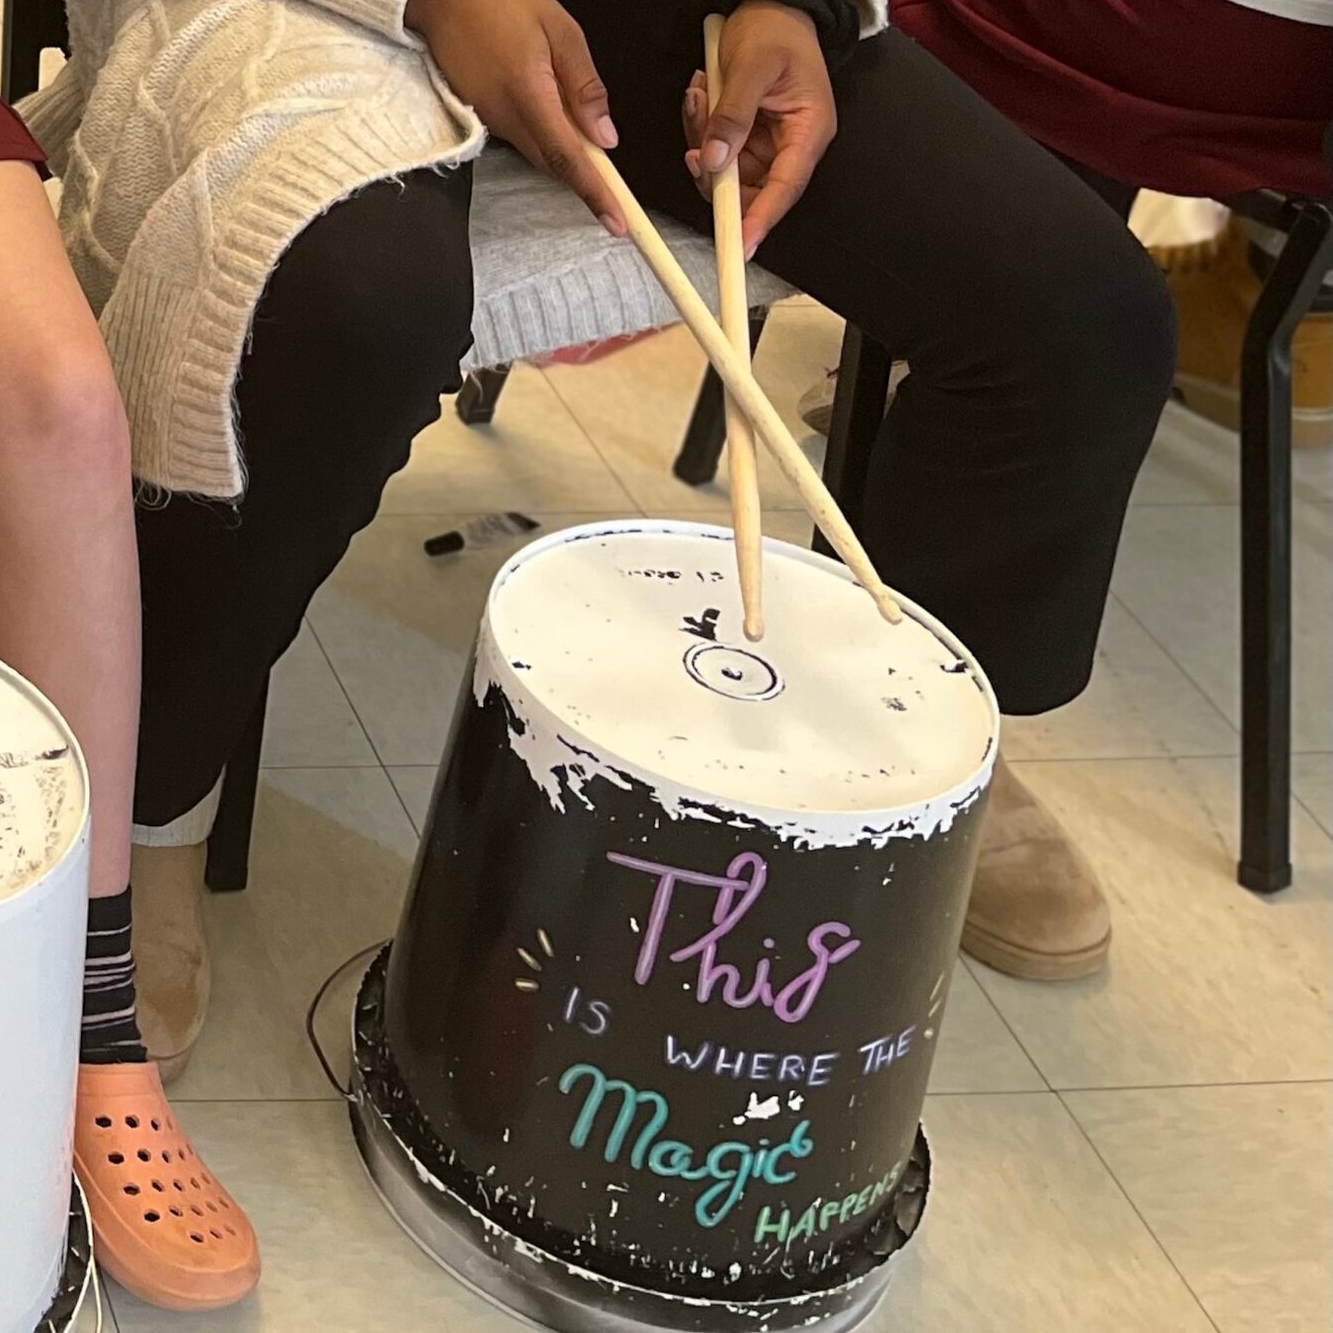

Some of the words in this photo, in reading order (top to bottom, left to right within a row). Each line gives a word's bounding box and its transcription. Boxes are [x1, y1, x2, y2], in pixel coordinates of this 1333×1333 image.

[563, 986, 613, 1035] IS
[666, 1035, 838, 1086] WHERE
[859, 1025, 917, 1074] THE
[558, 1064, 814, 1228] Magic
[754, 1162, 902, 1244] HAPPENS
